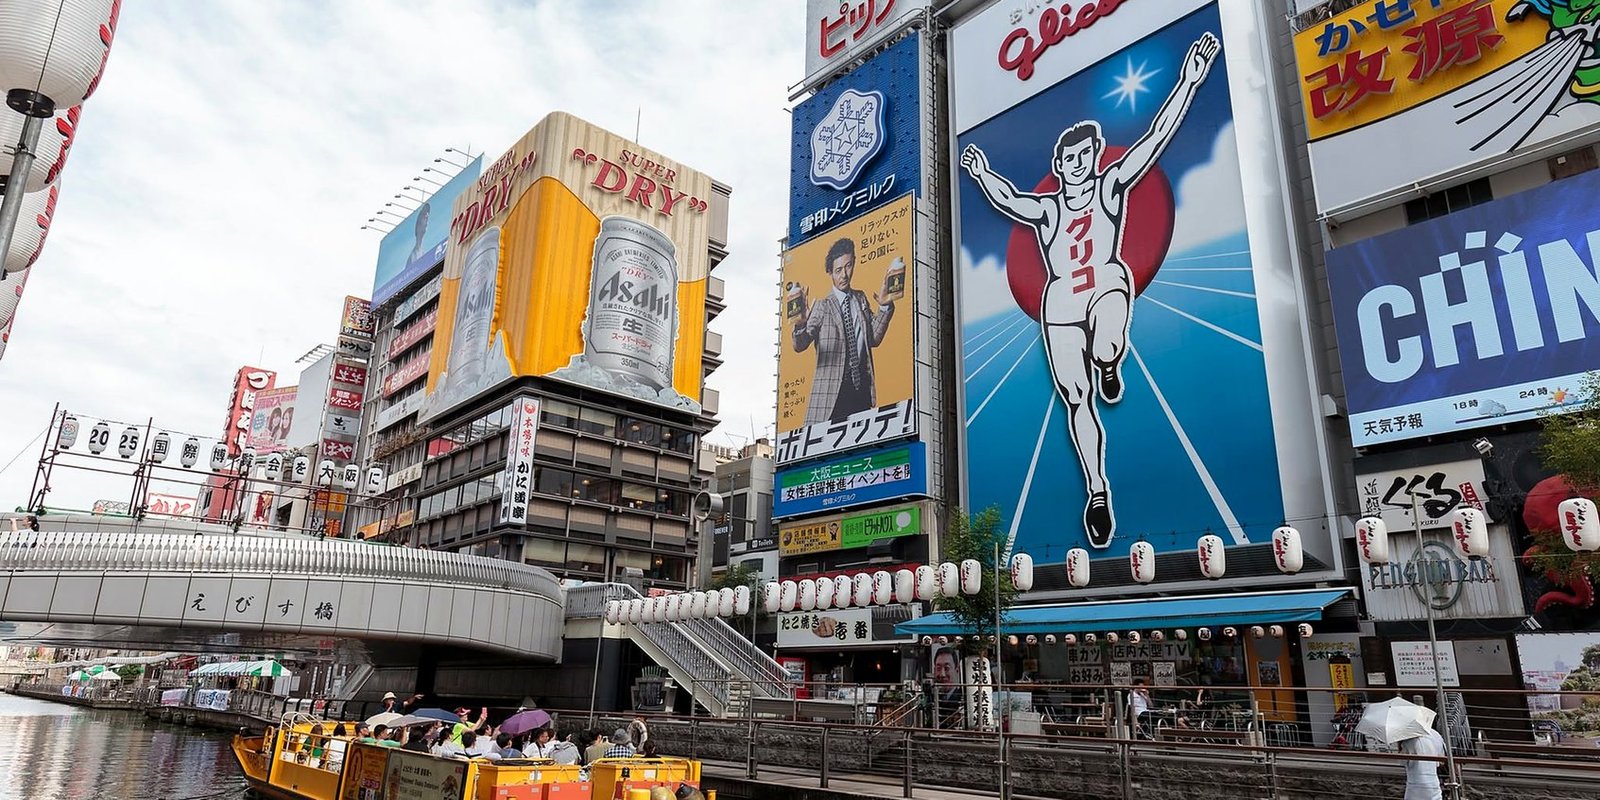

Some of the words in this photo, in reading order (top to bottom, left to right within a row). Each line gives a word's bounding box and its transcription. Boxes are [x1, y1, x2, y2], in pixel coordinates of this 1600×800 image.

[1305, 3, 1506, 120] 改源
[477, 150, 515, 193] SUPER
[619, 149, 677, 182] SUPER
[800, 174, 895, 235] 雪印メグミルク
[860, 205, 908, 234] リラックスが
[1066, 208, 1096, 294] グリコ
[599, 270, 669, 320] Asahi
[612, 332, 652, 350] スーパードライ
[622, 318, 643, 336] 生
[620, 357, 640, 370] 350ml
[1363, 413, 1423, 437] 天気予報
[810, 457, 873, 482] 大阪ニュース
[1363, 478, 1382, 519] 道頓
[1382, 472, 1461, 518] くくる
[191, 593, 334, 622] えびす橋
[781, 614, 820, 630] たこ焼き
[1068, 647, 1100, 662] 串カツ
[1071, 668, 1104, 683] お好み
